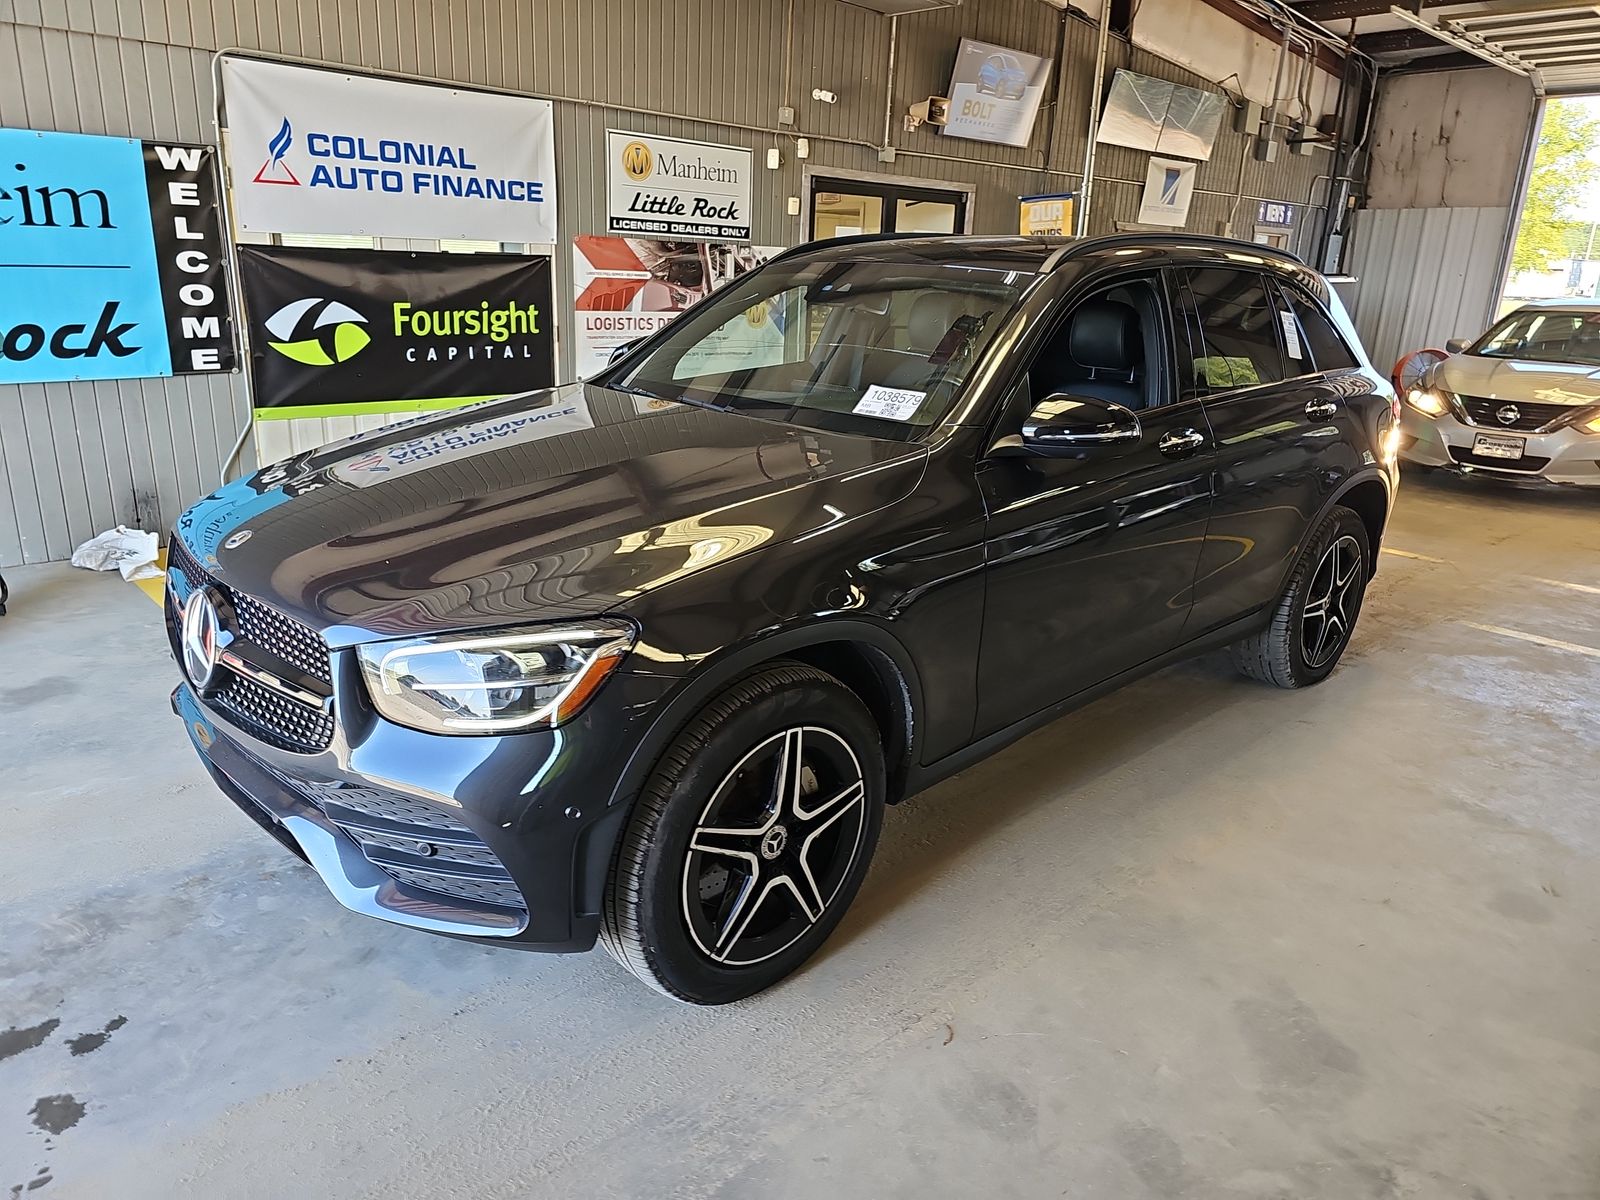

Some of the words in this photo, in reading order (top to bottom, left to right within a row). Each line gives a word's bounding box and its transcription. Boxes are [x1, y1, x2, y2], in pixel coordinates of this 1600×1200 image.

[962, 99, 997, 120] BOLT
[307, 132, 477, 170] COLONIAL
[656, 153, 739, 183] Manheim
[310, 164, 402, 193] AUTO
[413, 172, 544, 203] FINANCE
[628, 192, 687, 216] Little
[690, 198, 740, 221] Rock
[612, 219, 668, 232] LICENSED
[671, 222, 719, 235] DEALERS
[721, 227, 747, 237] ONLY
[154, 146, 221, 370] WELCOME
[0, 301, 143, 361] ock
[393, 300, 540, 343] Foursight
[586, 317, 654, 331] LOGISTICS
[406, 344, 532, 362] CAPITAL
[871, 389, 923, 406] 1038579
